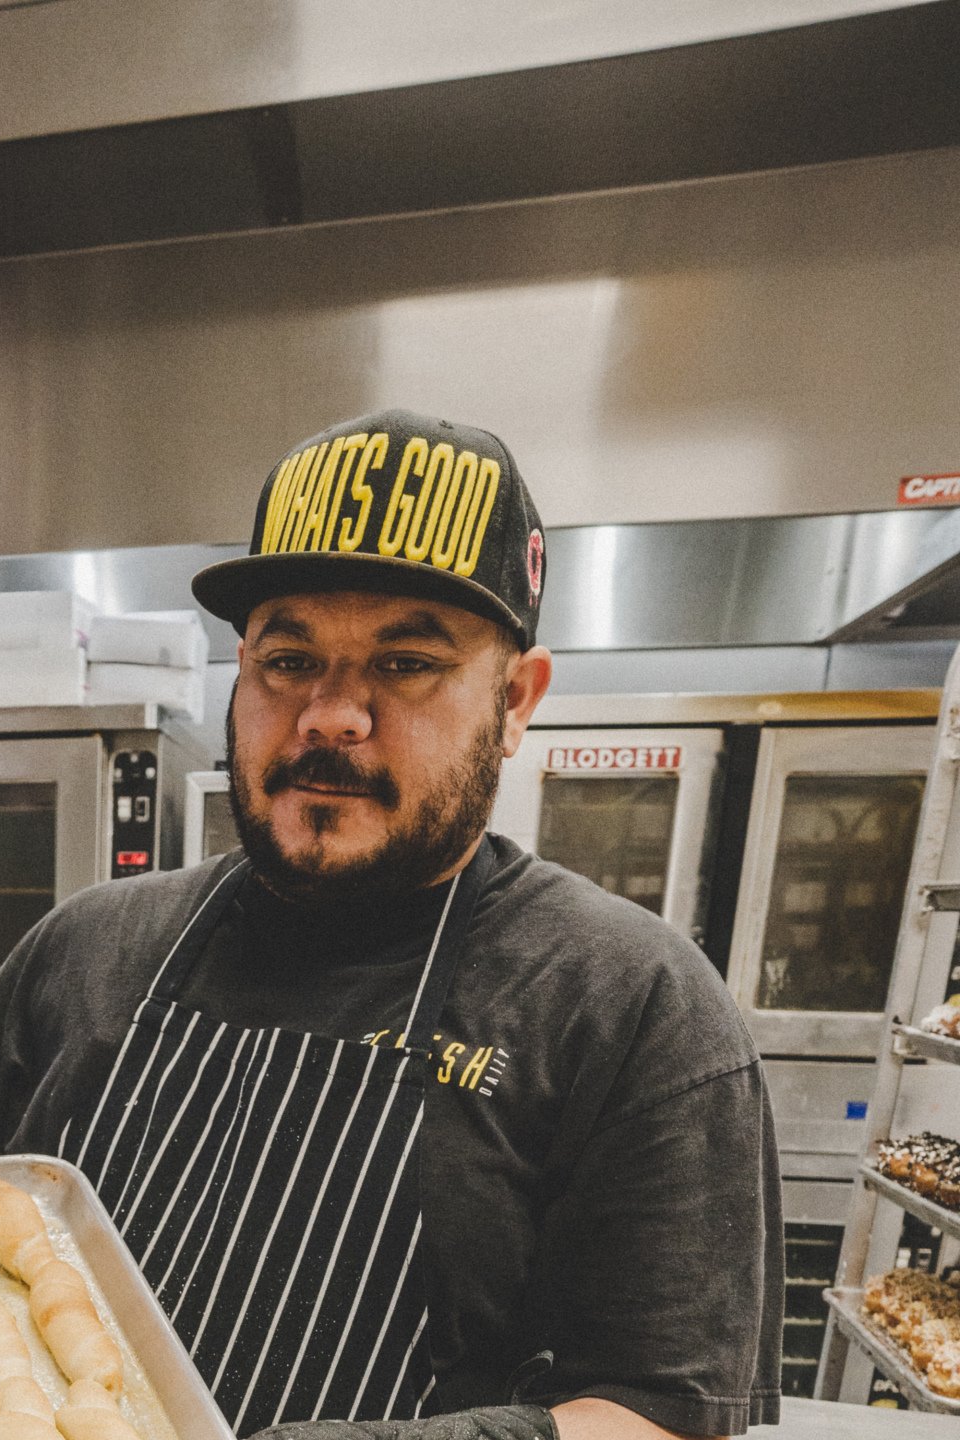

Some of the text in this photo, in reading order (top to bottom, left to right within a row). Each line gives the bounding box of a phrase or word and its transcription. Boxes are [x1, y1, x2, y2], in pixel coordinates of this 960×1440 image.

[261, 432, 500, 577] WHATS GOOD
[549, 748, 680, 769] BLODGETT
[478, 1047, 510, 1097] DAILY
